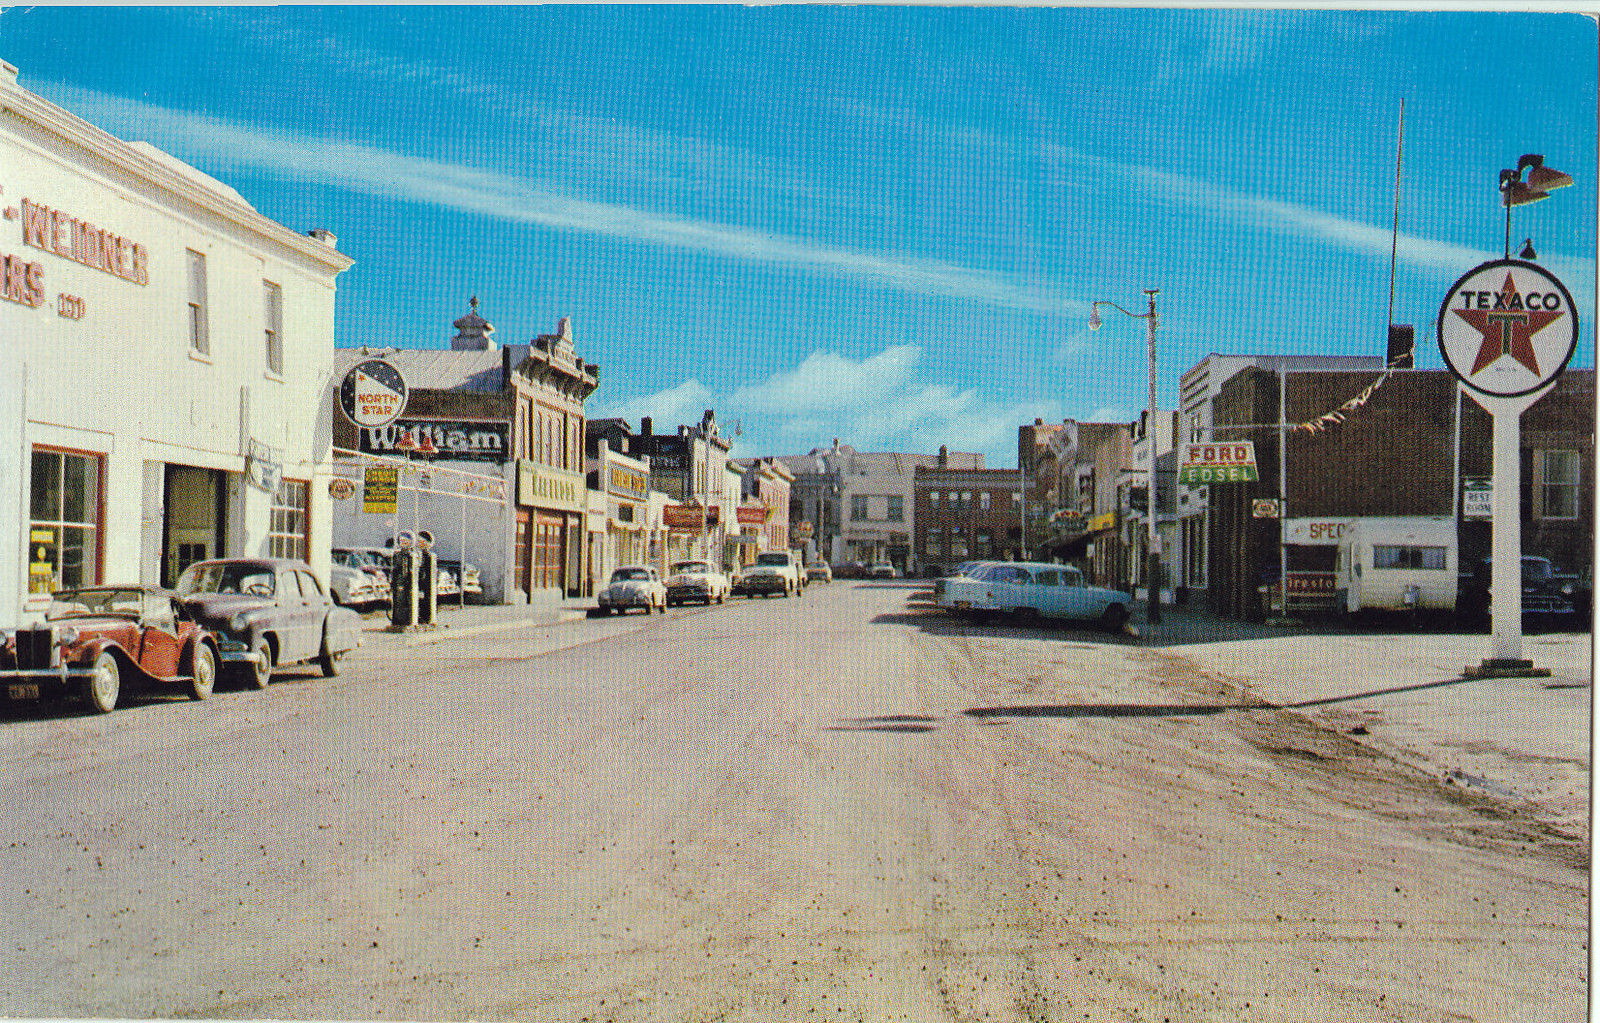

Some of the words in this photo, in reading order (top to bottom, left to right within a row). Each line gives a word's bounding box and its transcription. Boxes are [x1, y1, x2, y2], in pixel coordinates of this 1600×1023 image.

[1460, 290, 1561, 311] TEXACO
[358, 393, 399, 404] NORTH
[361, 405, 393, 416] STAR
[1189, 446, 1248, 462] FORD
[1188, 467, 1252, 482] EDSEL
[1468, 493, 1490, 502] REST
[1310, 522, 1346, 539] SPEC
[1287, 577, 1336, 589] iresto
